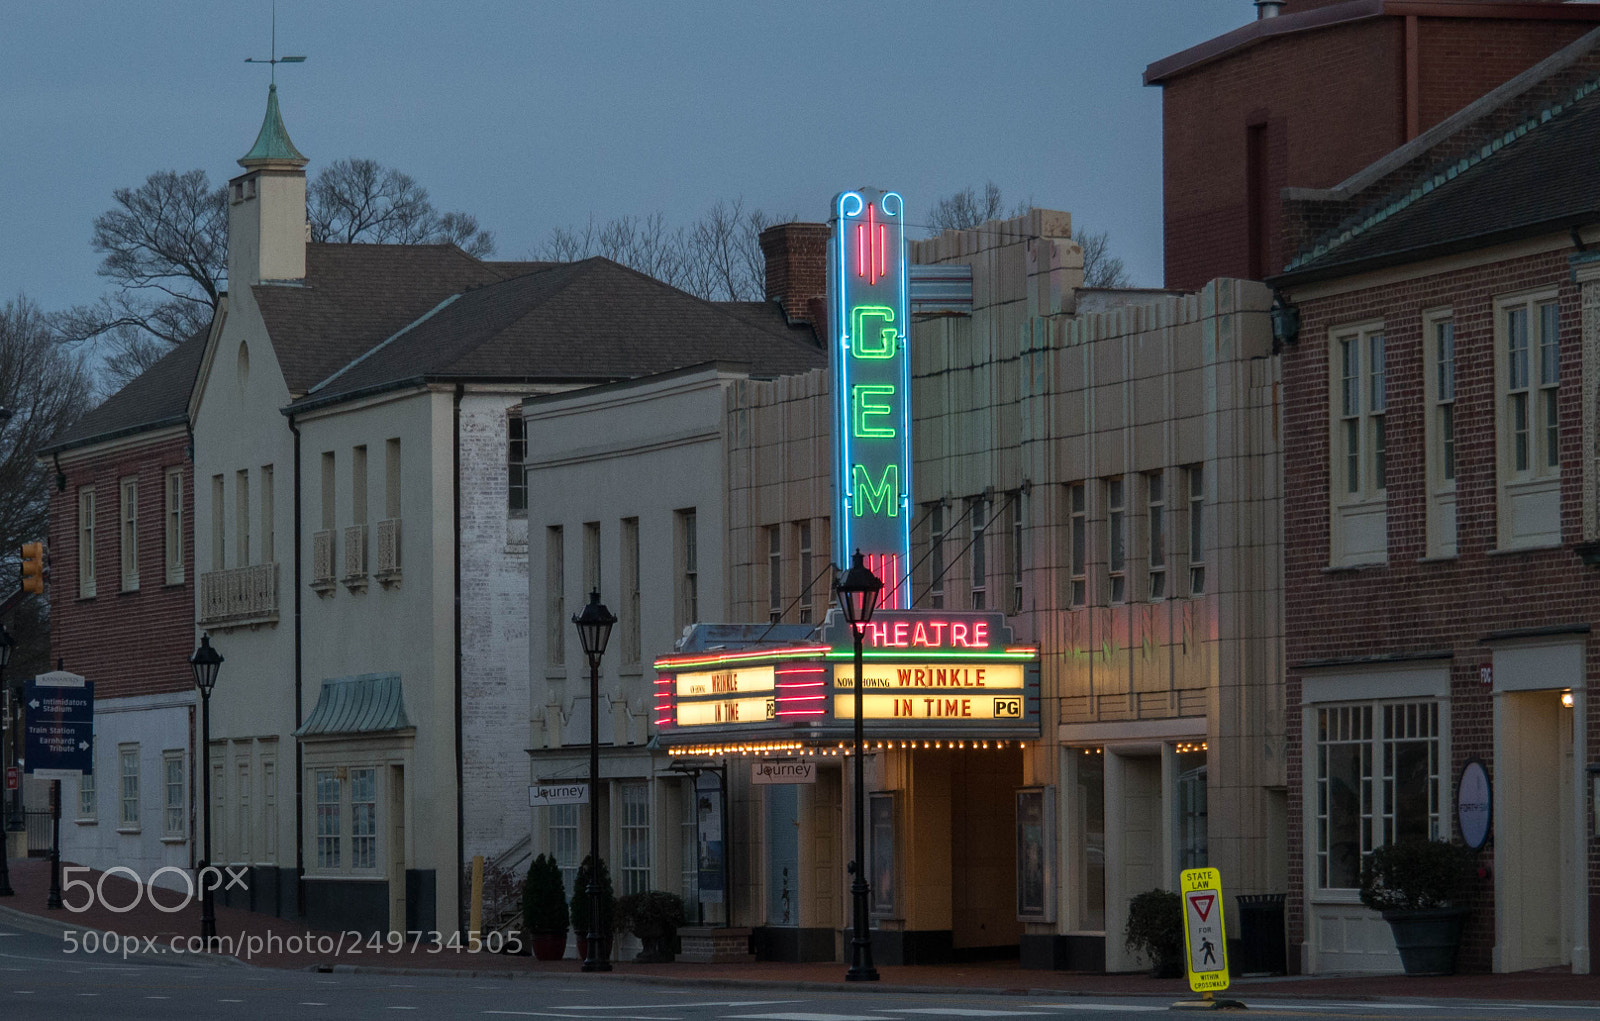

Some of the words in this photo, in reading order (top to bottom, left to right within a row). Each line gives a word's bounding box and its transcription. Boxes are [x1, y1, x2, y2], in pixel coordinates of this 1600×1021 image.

[851, 304, 899, 518] GEM
[850, 622, 989, 647] THEATRE
[862, 678, 890, 687] HOWING
[897, 669, 986, 687] WRINKLE
[1480, 667, 1491, 683] FDC
[711, 674, 738, 694] WRINKLE
[43, 698, 87, 706] Intimidators
[894, 699, 913, 716] IN
[924, 699, 972, 716] TIME
[995, 701, 1019, 715] PG
[715, 704, 721, 722] IN
[725, 703, 739, 722] TIME
[766, 703, 774, 717] PG
[756, 762, 812, 778] Journey
[533, 784, 584, 800] Journey
[1186, 871, 1213, 881] STATE
[1191, 881, 1209, 889] LAW
[1194, 980, 1227, 989] CROSSWALK
